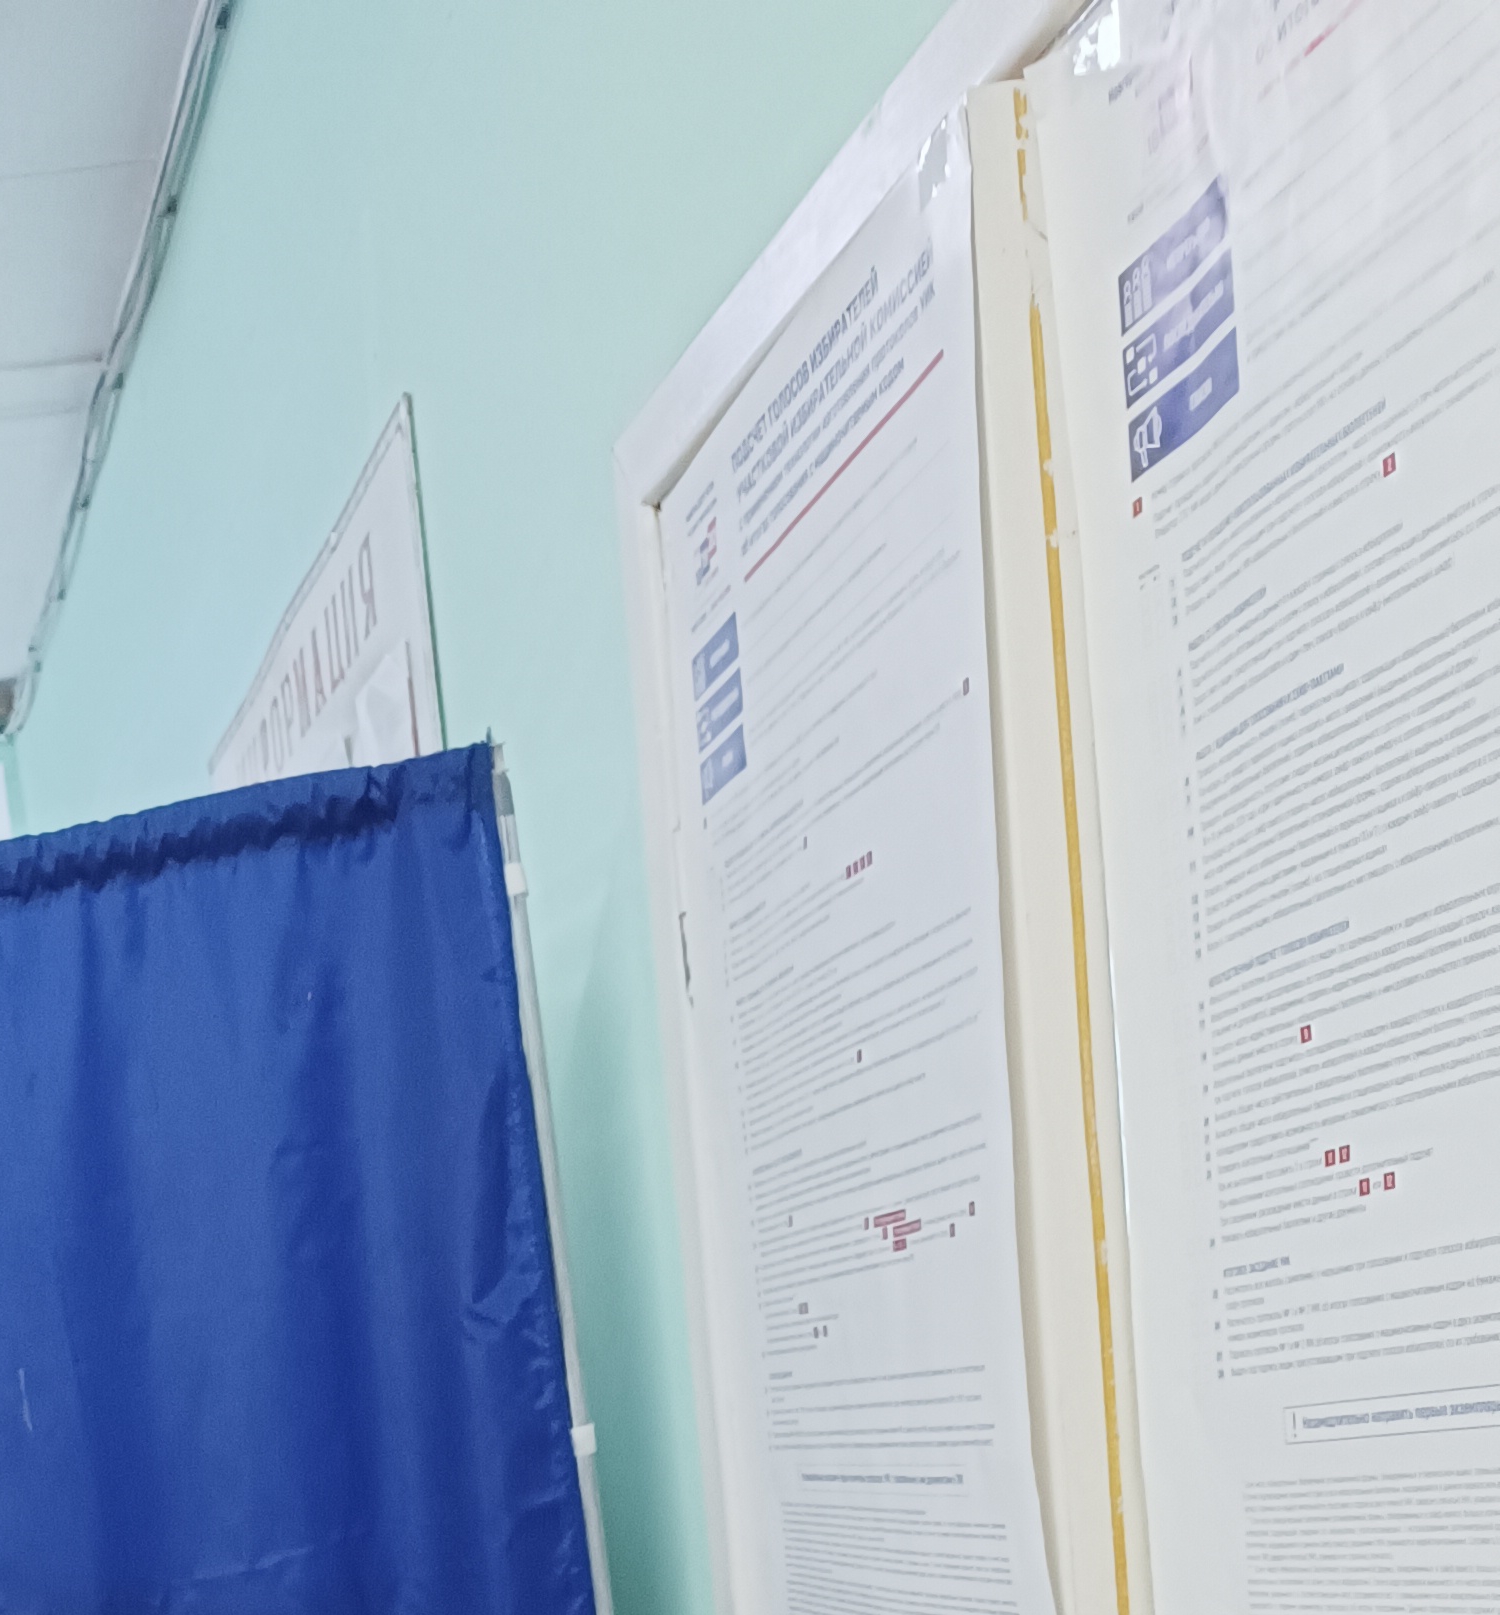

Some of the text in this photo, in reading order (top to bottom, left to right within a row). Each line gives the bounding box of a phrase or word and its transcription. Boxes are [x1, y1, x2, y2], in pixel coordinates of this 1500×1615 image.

[767, 361, 809, 427] ГОЛОСОВ
[809, 265, 879, 373] ИЗБИРАТЕЛЕЙ
[789, 321, 867, 438] ИЗБИРАТЕЛЬНОЙ
[869, 236, 934, 340] КОМИССИЕЙ
